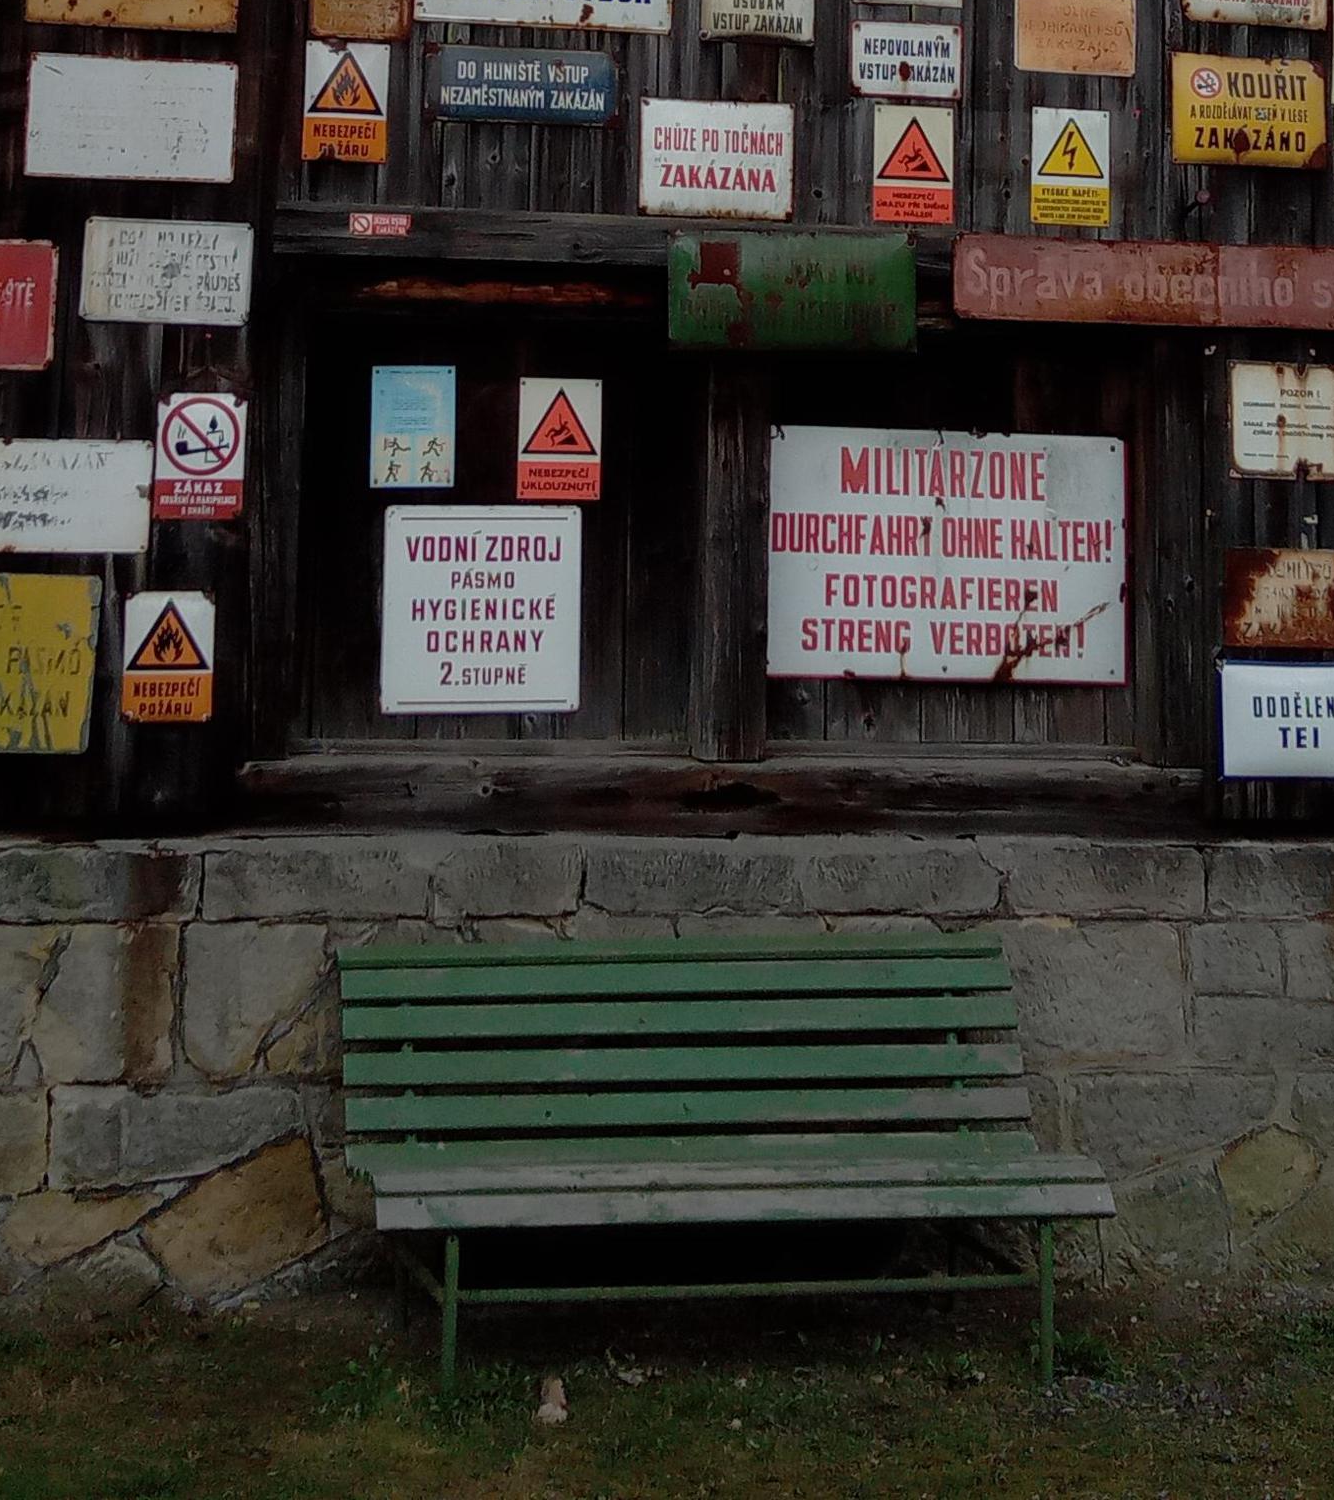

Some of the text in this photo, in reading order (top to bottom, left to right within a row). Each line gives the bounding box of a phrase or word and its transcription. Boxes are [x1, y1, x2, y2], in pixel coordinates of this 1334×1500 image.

[712, 10, 804, 36] VSTUP ZAKÁZÁN
[864, 36, 950, 58] NEPOVOLANÝM
[458, 60, 589, 84] DO HLINIŠTĚ VSTUP
[441, 83, 605, 111] NEZAMĚSTNANÝM ZAKÁZÁN
[1227, 70, 1308, 101] KOUŘIT
[313, 122, 377, 139] NEBEZPEČÍ
[654, 125, 783, 155] CHŮZE PO TOČNÁCH
[660, 161, 776, 193] ZAKÁZÁNA
[528, 467, 590, 479] NEBEZPEČÍ
[173, 481, 223, 494] ZÁKAZ
[521, 479, 597, 492] UKLOUZNUTÍ
[406, 531, 562, 562] VODNÍ ZDROJ
[771, 511, 1113, 564] DURCHFAHRT OHNE HALTEN!
[451, 569, 515, 589] PÁSMO
[824, 572, 1059, 614] FOTOGRAFIEREN
[411, 593, 556, 622] HYGIENICKÉ
[427, 631, 544, 653] OCHRANY
[134, 680, 199, 700] NEBEZPEČÍ
[138, 700, 193, 717] POŽÁRU
[1279, 726, 1321, 749] TEI
